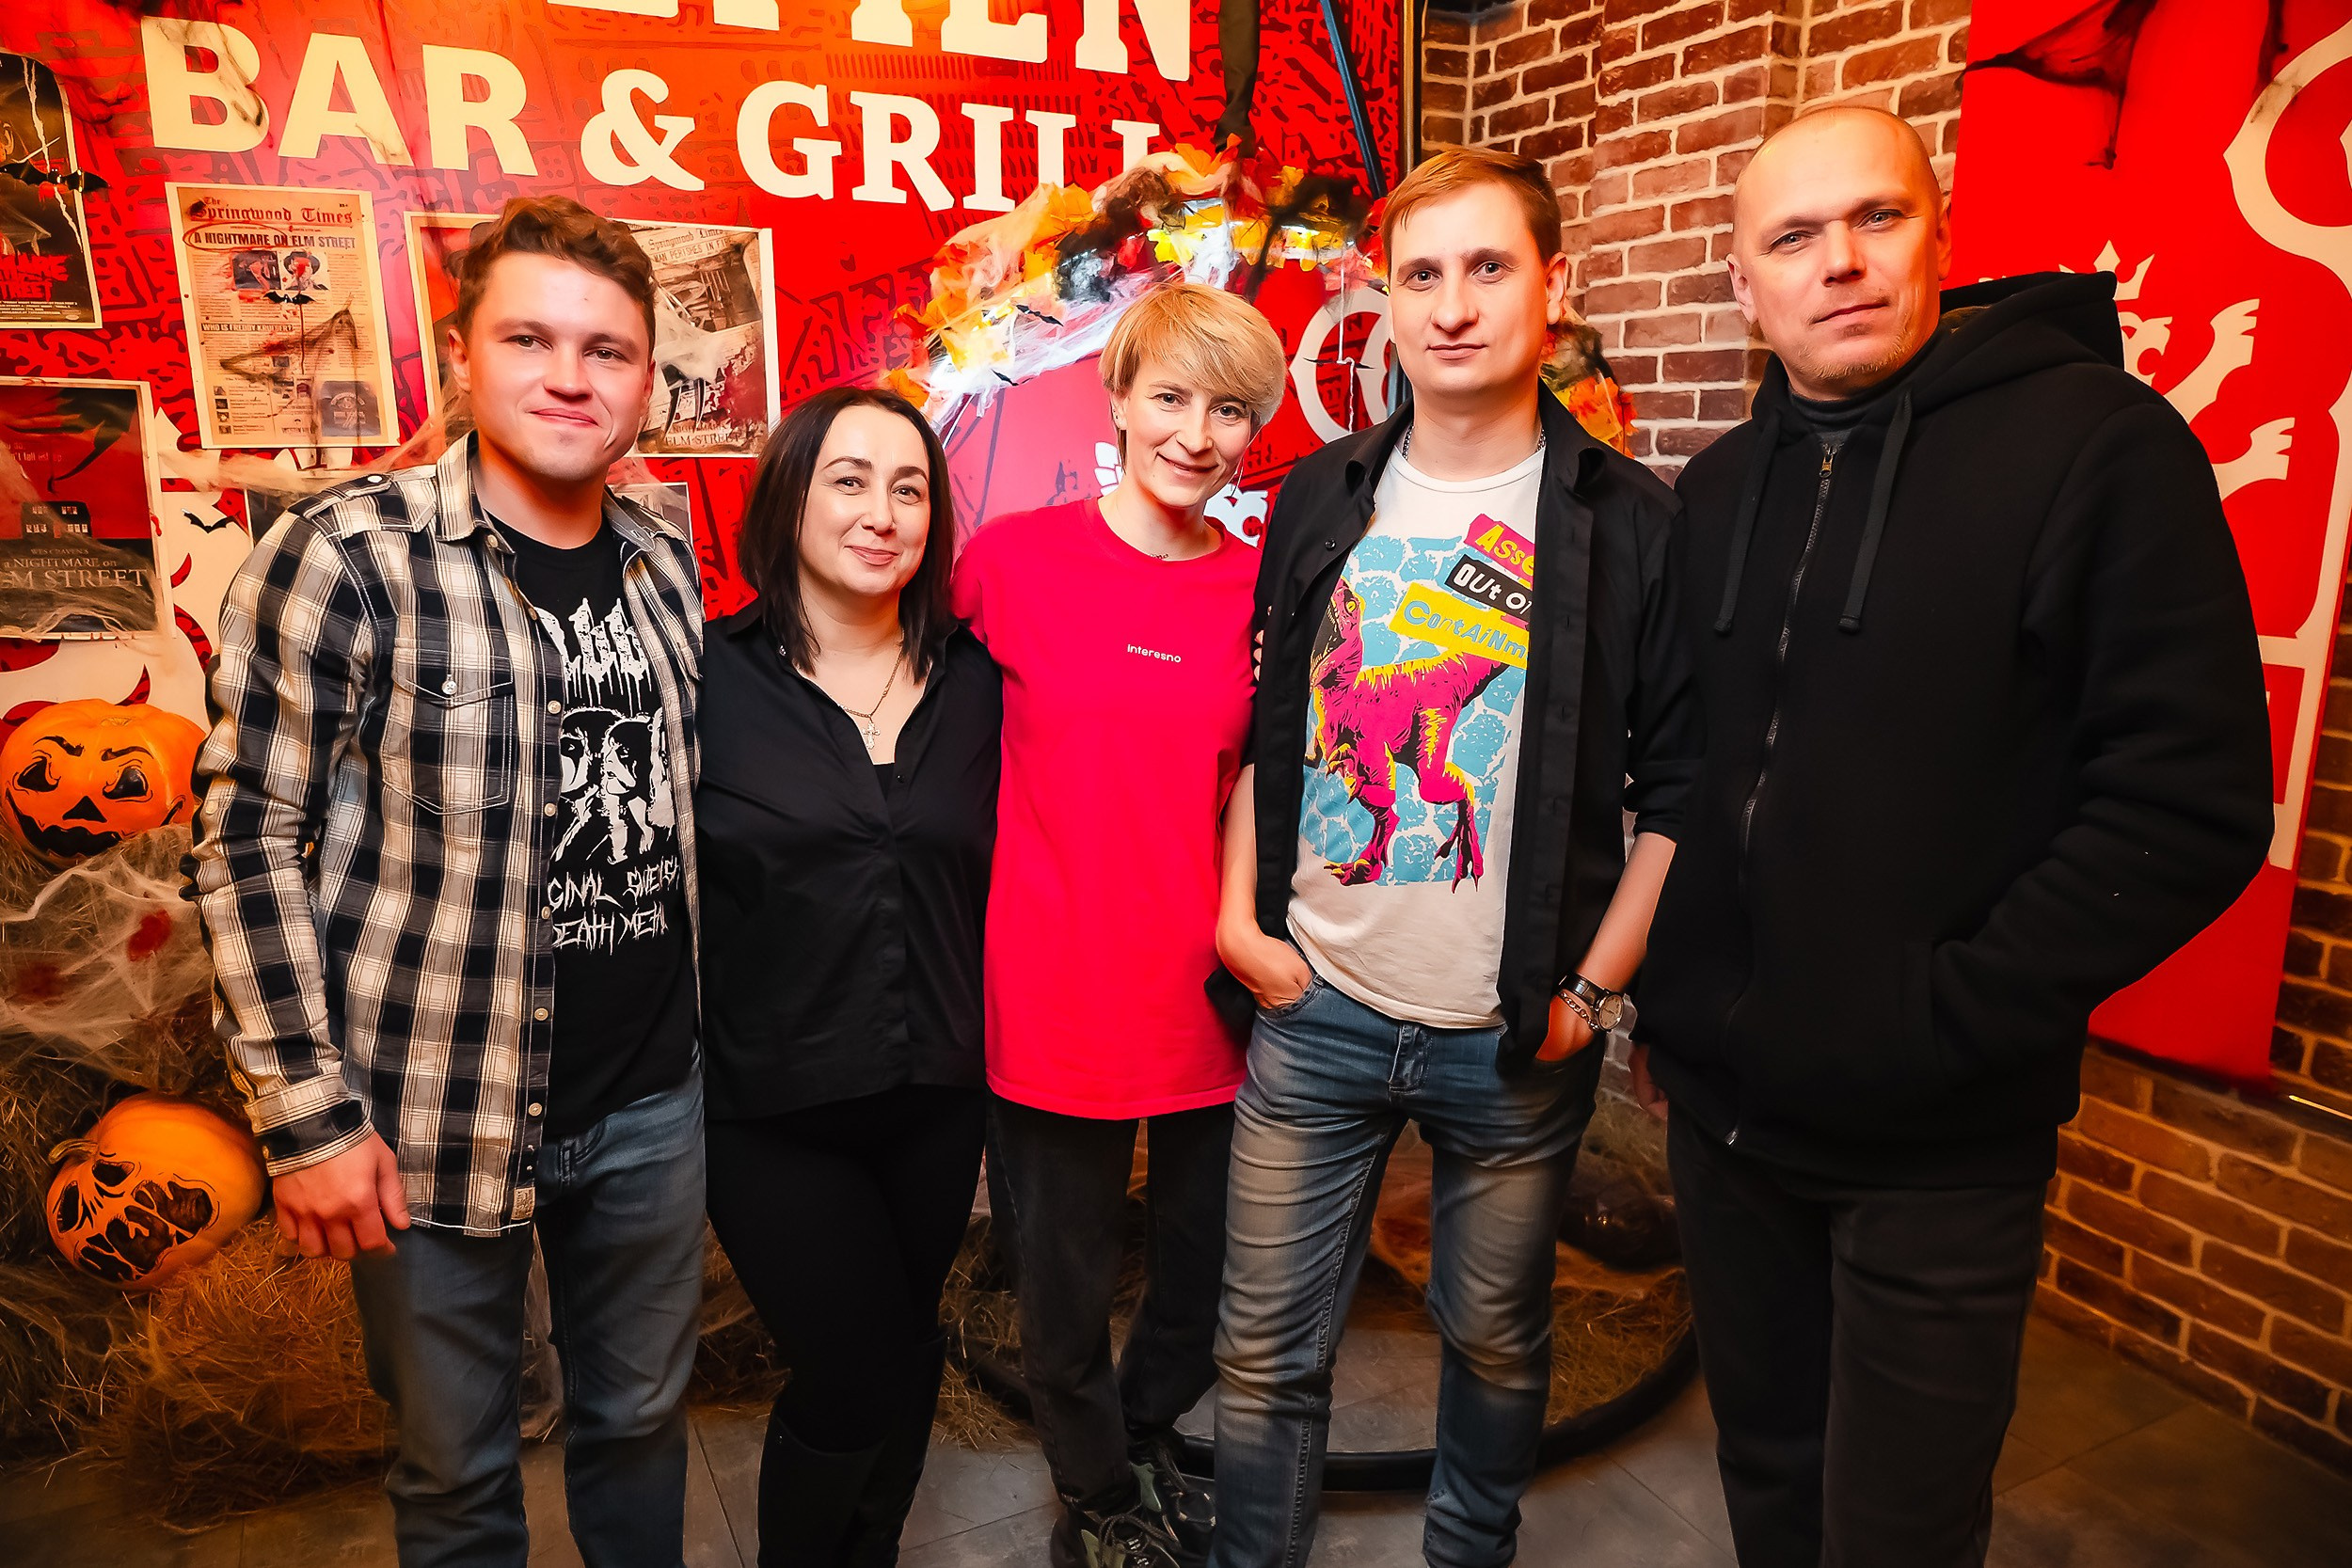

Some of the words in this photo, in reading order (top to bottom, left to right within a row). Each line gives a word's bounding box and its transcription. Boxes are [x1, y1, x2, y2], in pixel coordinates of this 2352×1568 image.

[141, 16, 538, 177] BAR
[580, 68, 706, 192] &
[194, 231, 202, 245] A
[205, 232, 271, 246] NIGHTMARE
[274, 235, 289, 247] ON
[292, 235, 315, 247] ELM
[318, 236, 356, 250] STREET
[706, 242, 715, 252] IN
[13, 558, 100, 568] NIGHTMARE
[45, 568, 147, 589] STREET
